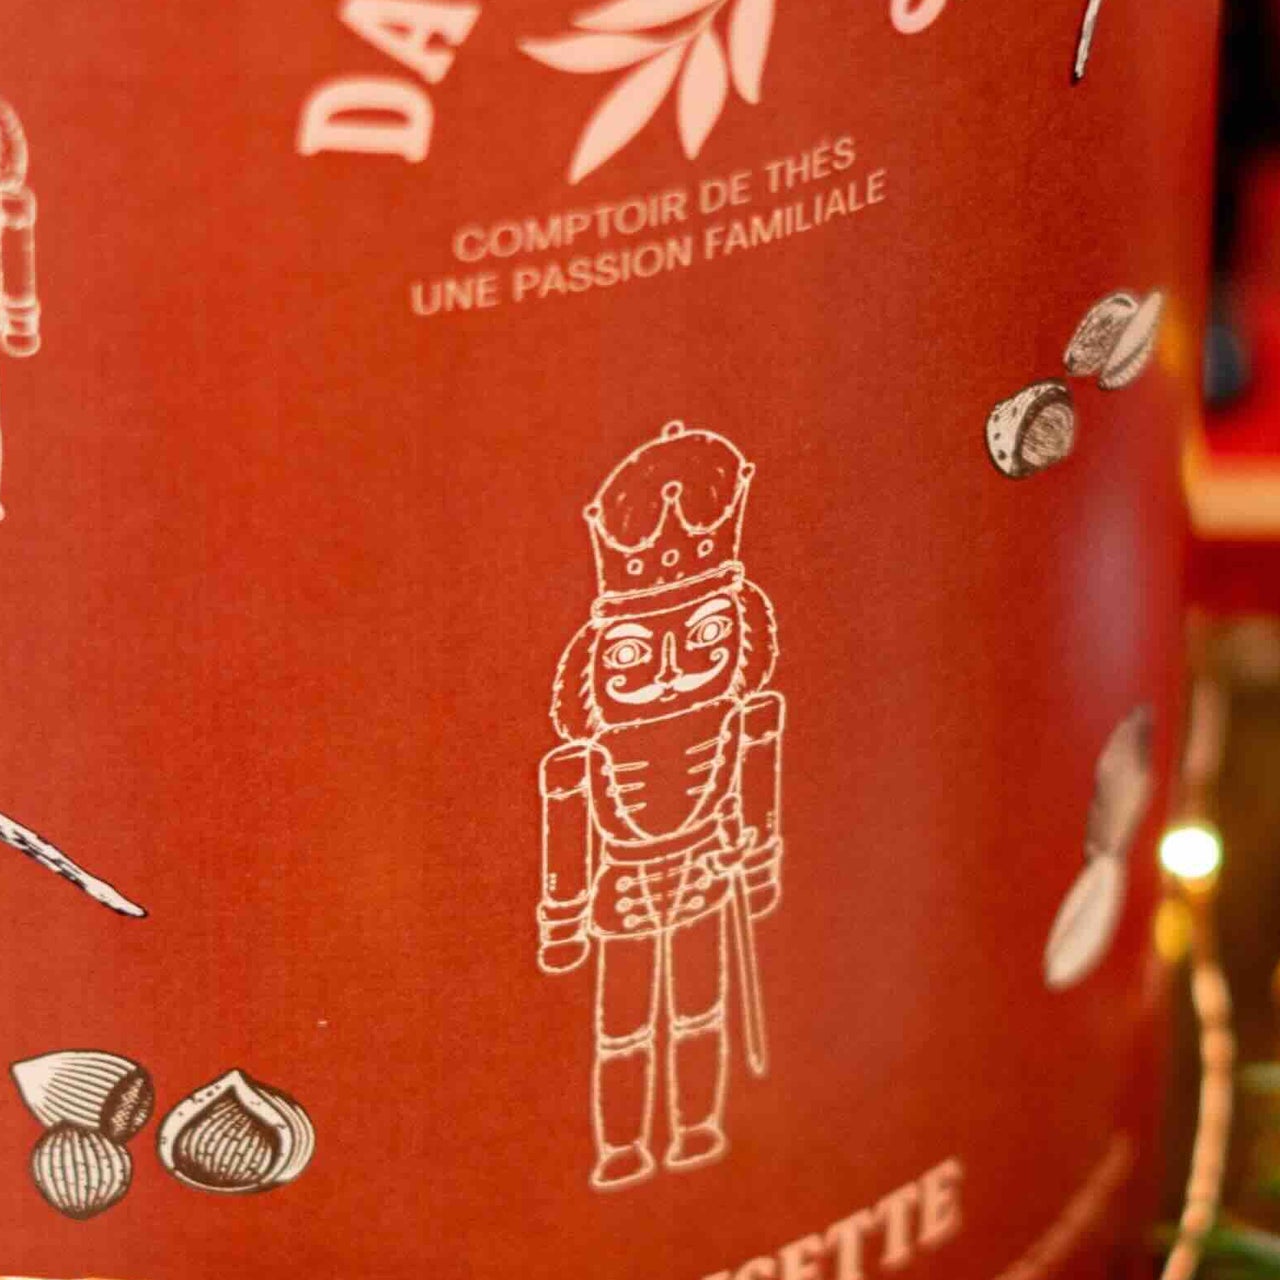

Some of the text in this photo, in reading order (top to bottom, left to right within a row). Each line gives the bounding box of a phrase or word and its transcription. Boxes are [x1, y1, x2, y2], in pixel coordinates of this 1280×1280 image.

[410, 169, 887, 316] UNE PASSION FAMILIALE
[453, 191, 687, 263] COMPTOIR
[699, 170, 752, 214] DE
